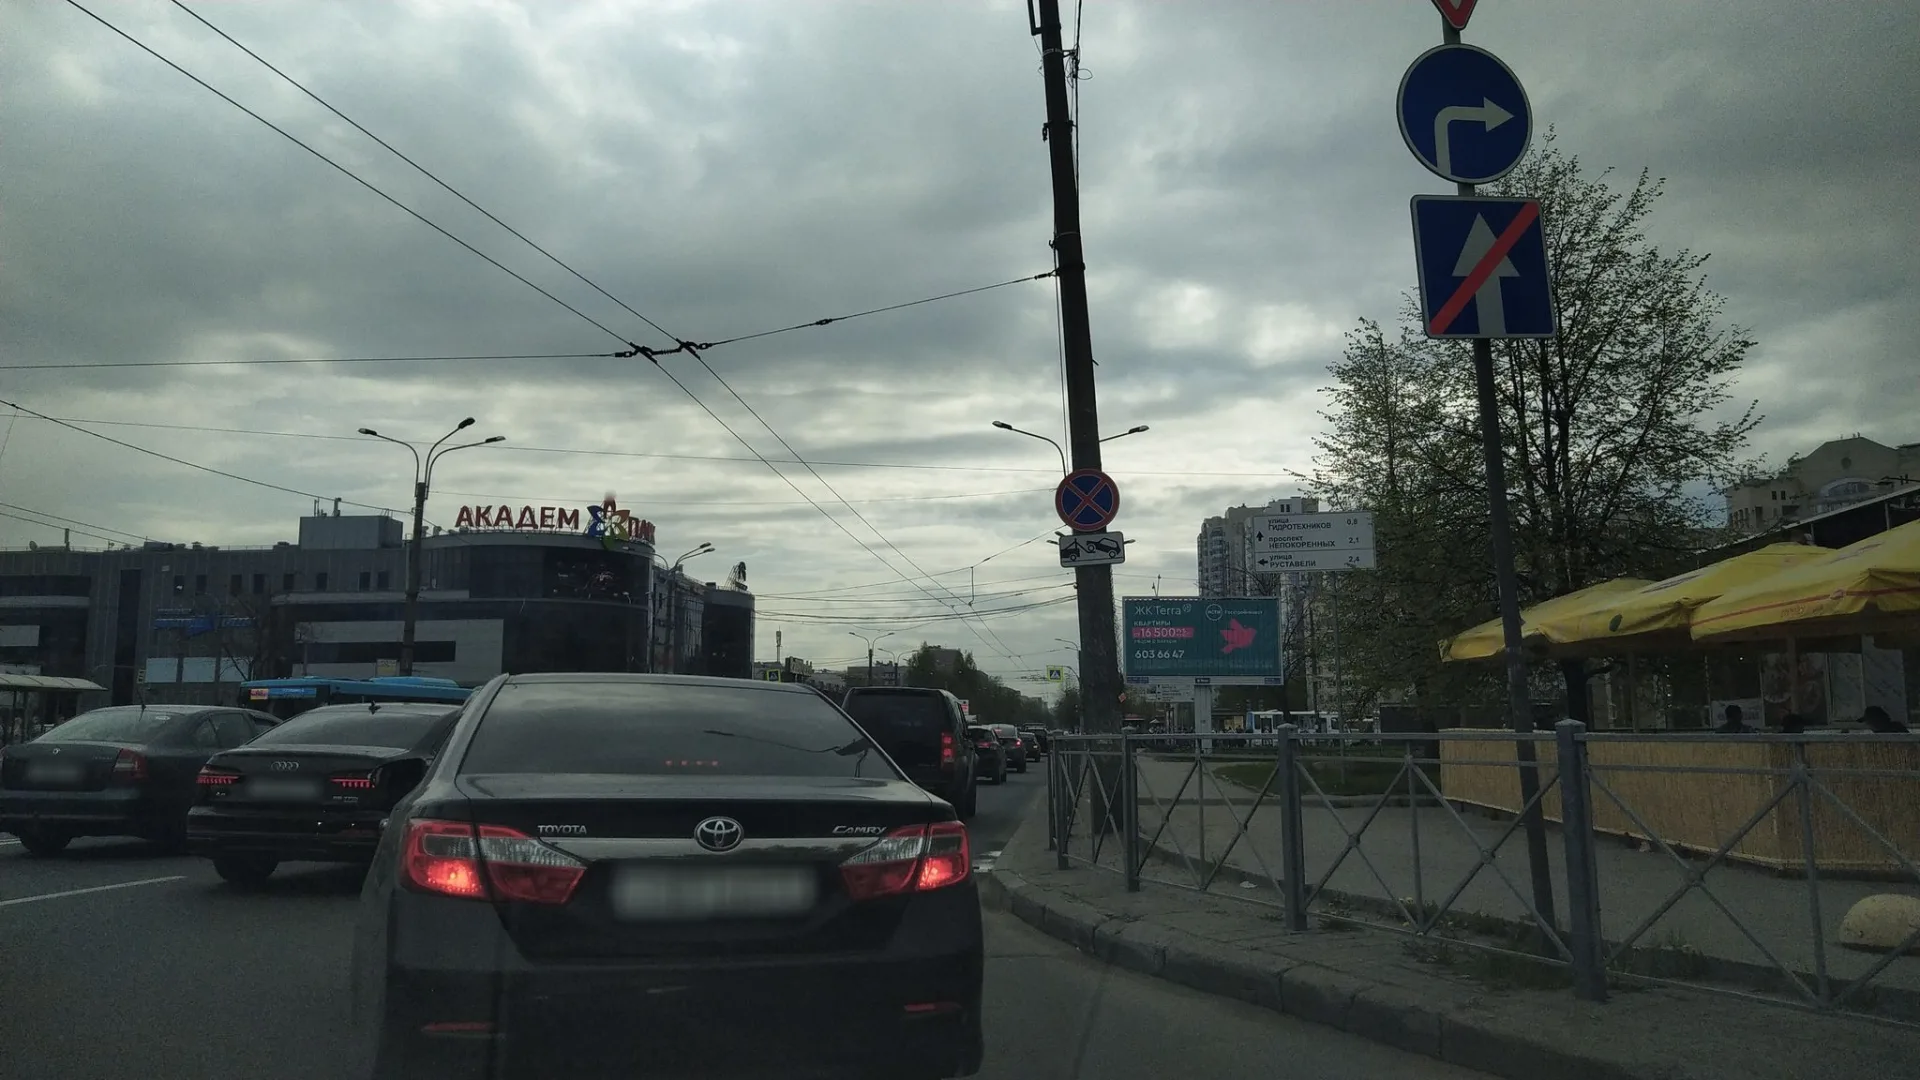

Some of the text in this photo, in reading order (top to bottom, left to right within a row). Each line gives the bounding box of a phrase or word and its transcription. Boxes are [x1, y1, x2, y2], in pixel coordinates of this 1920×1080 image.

[455, 505, 579, 529] АКАДЕМ
[1268, 522, 1331, 530] ГИДРОТЕХНИКОВ
[1268, 541, 1336, 549] НЕПОКОРЕННЫХ
[1348, 555, 1360, 563] 2,4
[1269, 560, 1317, 568] РУСТАВЕЛИ
[1134, 605, 1181, 615] ЖК Terra
[1154, 627, 1176, 638] 500
[1134, 649, 1185, 659] 603 66 47
[537, 825, 587, 834] TOYOTA
